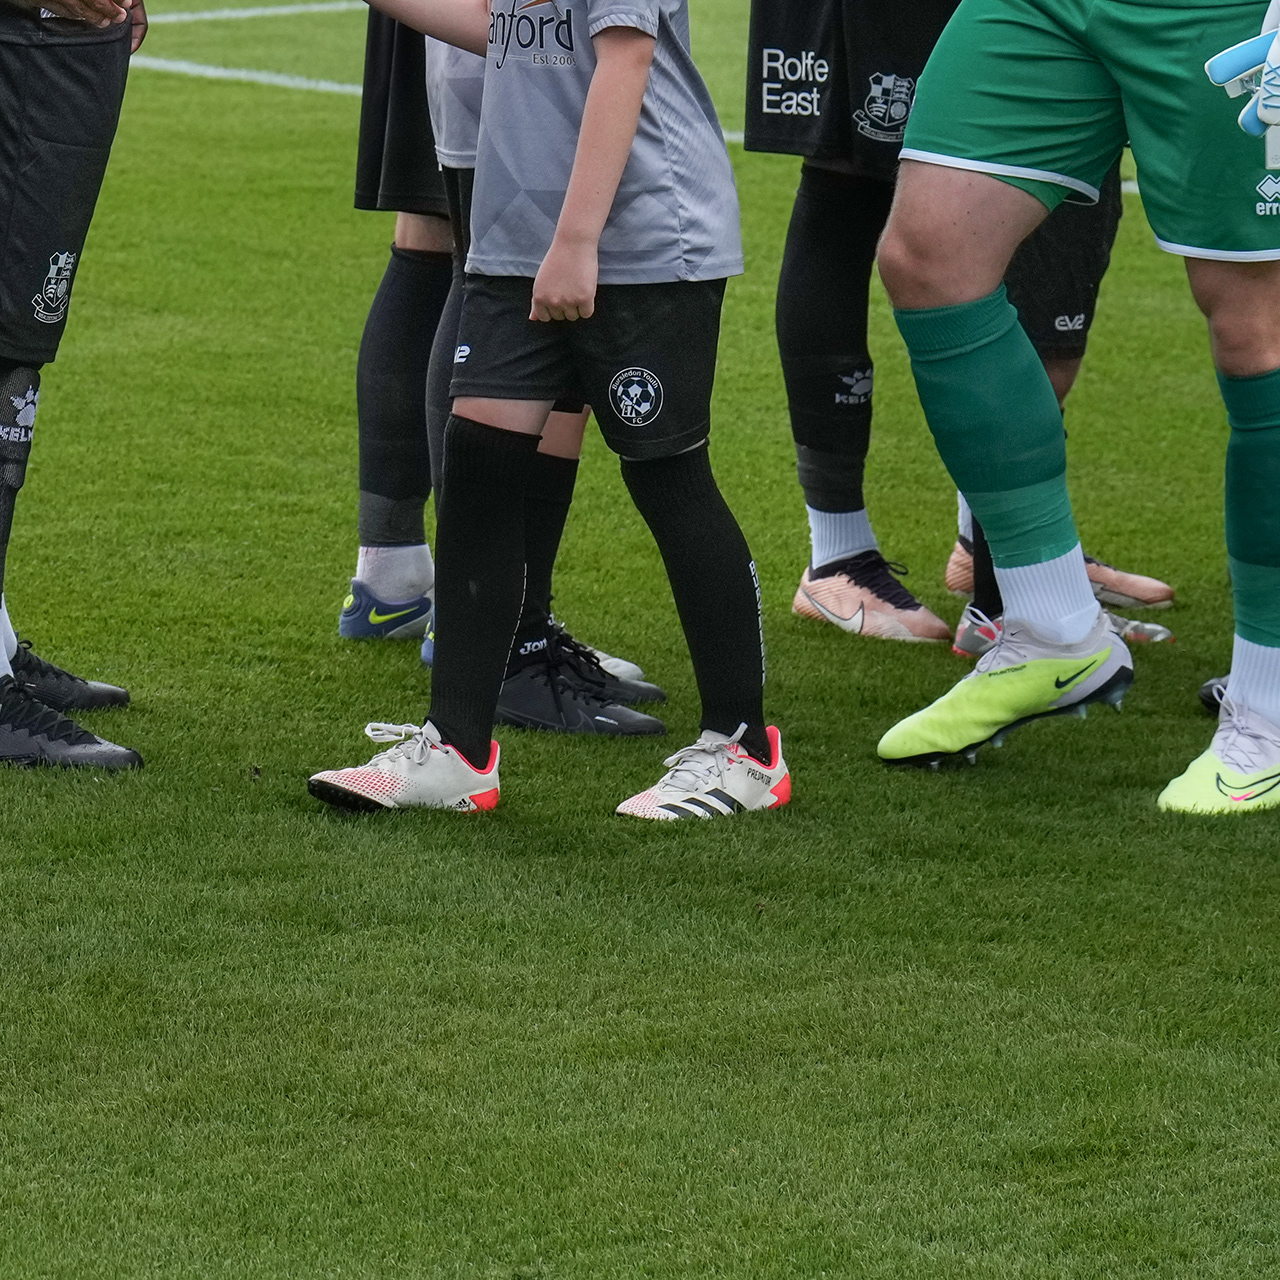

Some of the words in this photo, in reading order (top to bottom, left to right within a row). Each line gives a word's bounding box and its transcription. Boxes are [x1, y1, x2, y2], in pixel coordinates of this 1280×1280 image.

[533, 53, 549, 65] Est
[763, 49, 829, 82] Rolfe
[762, 83, 820, 116] East
[612, 370, 641, 391] Bursledon
[641, 371, 659, 390] Youth
